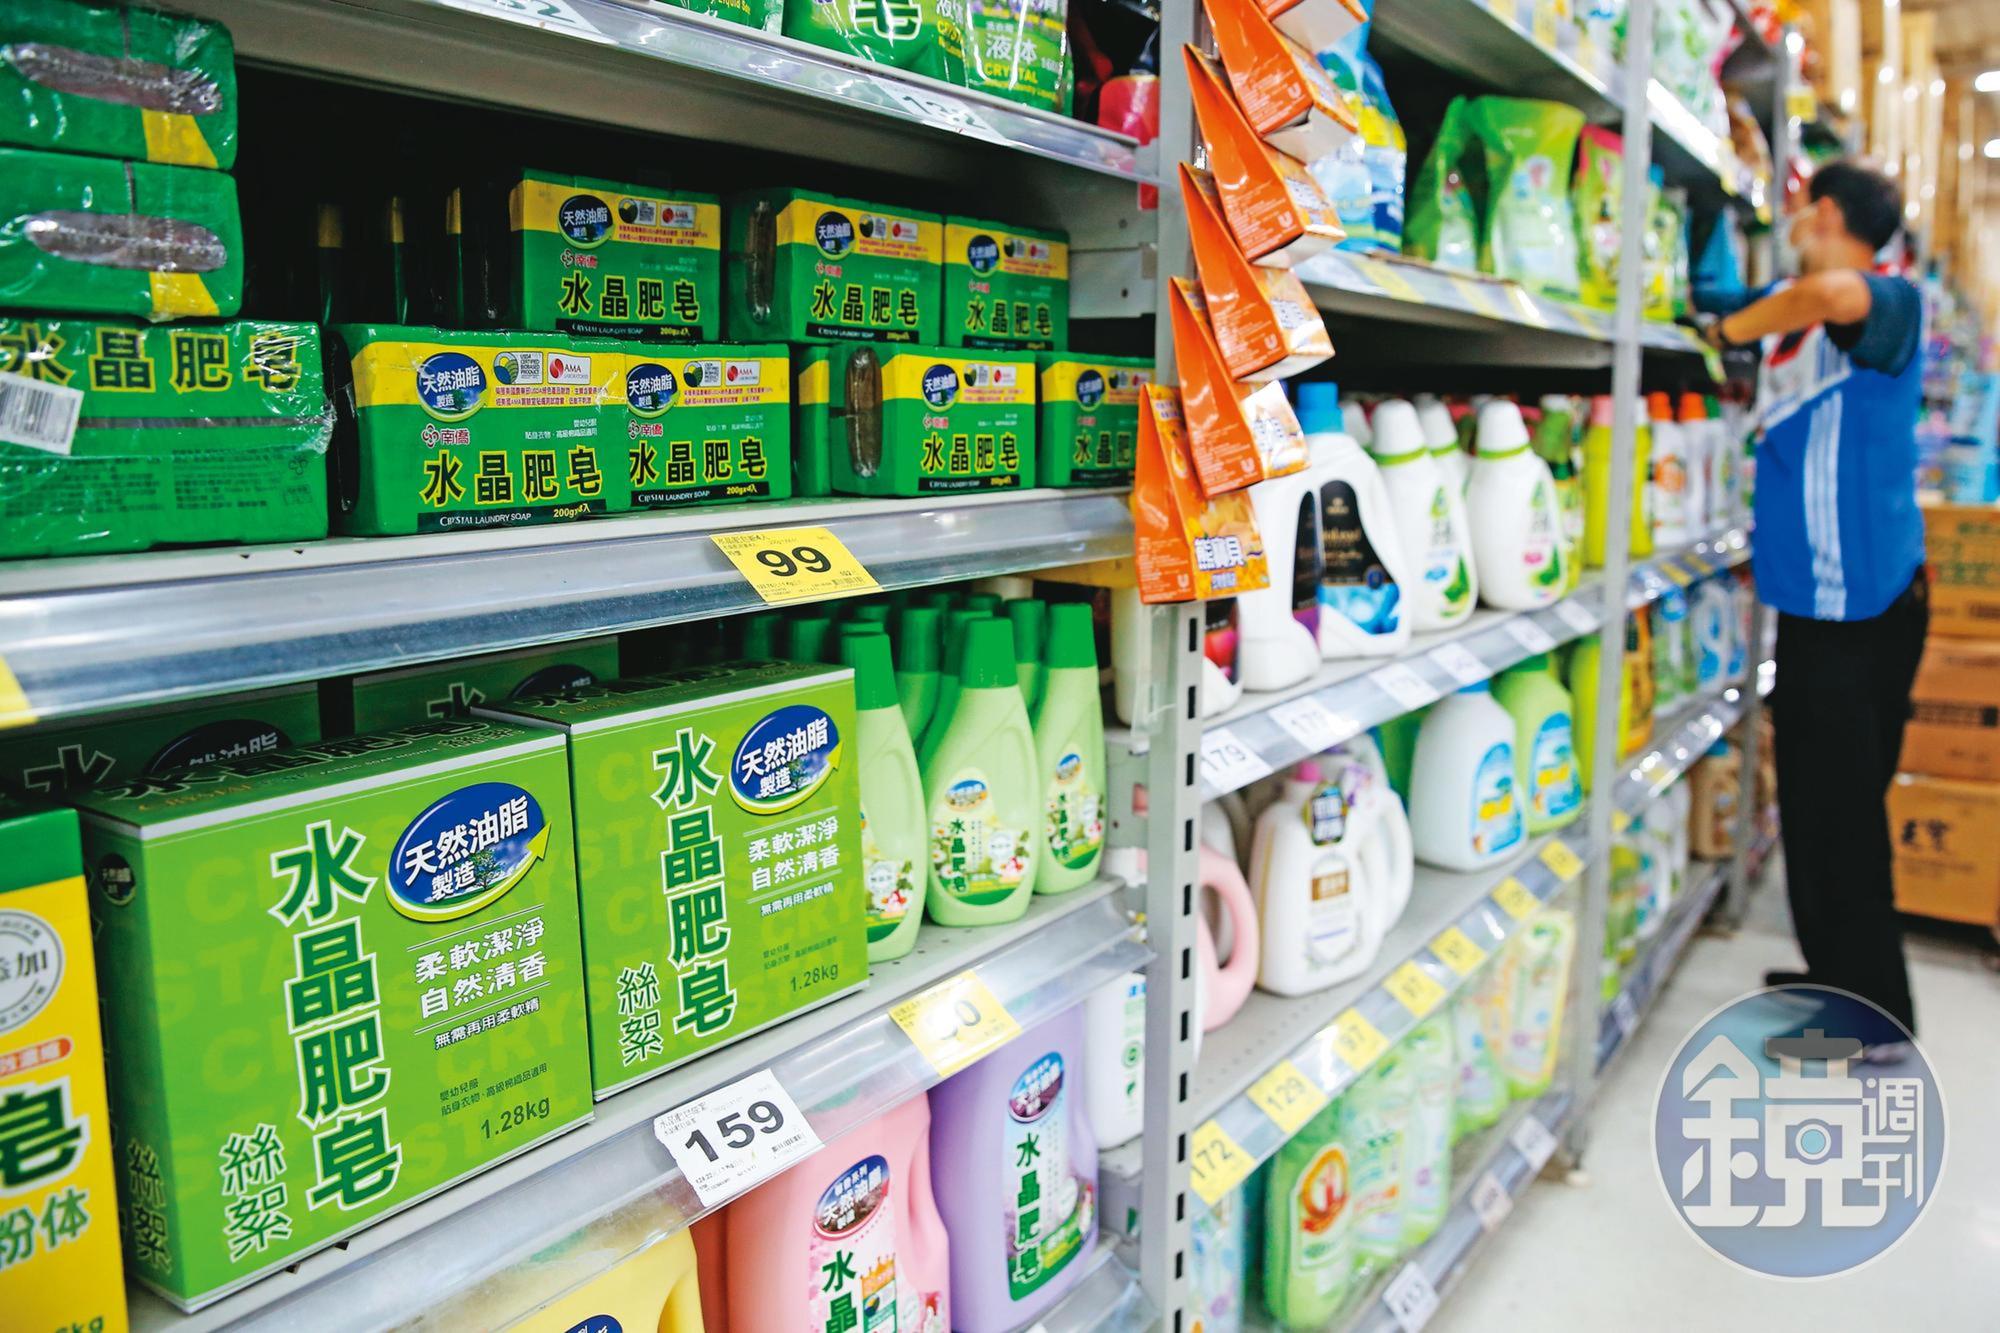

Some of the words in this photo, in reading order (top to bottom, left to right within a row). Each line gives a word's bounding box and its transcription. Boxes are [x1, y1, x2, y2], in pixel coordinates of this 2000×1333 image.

[495, 0, 576, 23] 2
[984, 62, 1038, 84] CRYTAL
[564, 207, 607, 227] 天然油脂
[558, 270, 699, 322] 水晶肥皂
[812, 279, 919, 326] 水晶肥皂
[966, 296, 1052, 336] 水晶肥皂
[0, 321, 302, 393] 水晶肥皂
[423, 366, 480, 395] 天然油脂
[565, 364, 581, 373] AMA
[436, 393, 455, 408] 製造
[628, 374, 673, 397] 天然油脂
[440, 428, 470, 445] 南僑
[921, 432, 1019, 474] 水晶肥皂
[419, 444, 602, 507] 水晶肥皂
[629, 436, 767, 486] 水晶肥皂
[475, 513, 510, 524] LAUNDRY
[511, 512, 531, 521] SOAP
[665, 490, 693, 501] LAUNDRY
[694, 489, 710, 498] SOAP
[756, 546, 831, 577] 99
[741, 716, 828, 784] 天然油脂
[759, 767, 792, 799] 製造
[405, 795, 528, 886] 天然油脂
[749, 816, 839, 863] 柔軟潔淨
[950, 817, 967, 892] 水晶肥皂
[430, 860, 476, 902] 製造
[651, 727, 738, 1038] 水晶肥皂
[751, 844, 840, 891] 自然清香
[760, 881, 834, 917] 無需再用柔軟精
[416, 917, 545, 984] 柔軟潔淨
[421, 951, 547, 1019] 自然清香
[790, 962, 839, 993] 1.28kg
[268, 820, 402, 1212] 水晶肥皂
[434, 997, 541, 1050] 無需再用柔軟精
[617, 962, 663, 1067] 絲絮
[1267, 1076, 1306, 1112] 129
[0, 1076, 91, 1191] 皂
[480, 1097, 551, 1139] 1.28kg
[685, 1100, 784, 1162] 159
[1190, 1139, 1233, 1180] 172
[128, 1138, 172, 1275] 絲絮
[219, 1123, 292, 1263] 絲絮
[1013, 1132, 1043, 1284] 水晶肥皂
[821, 1250, 858, 1333] 水晶
